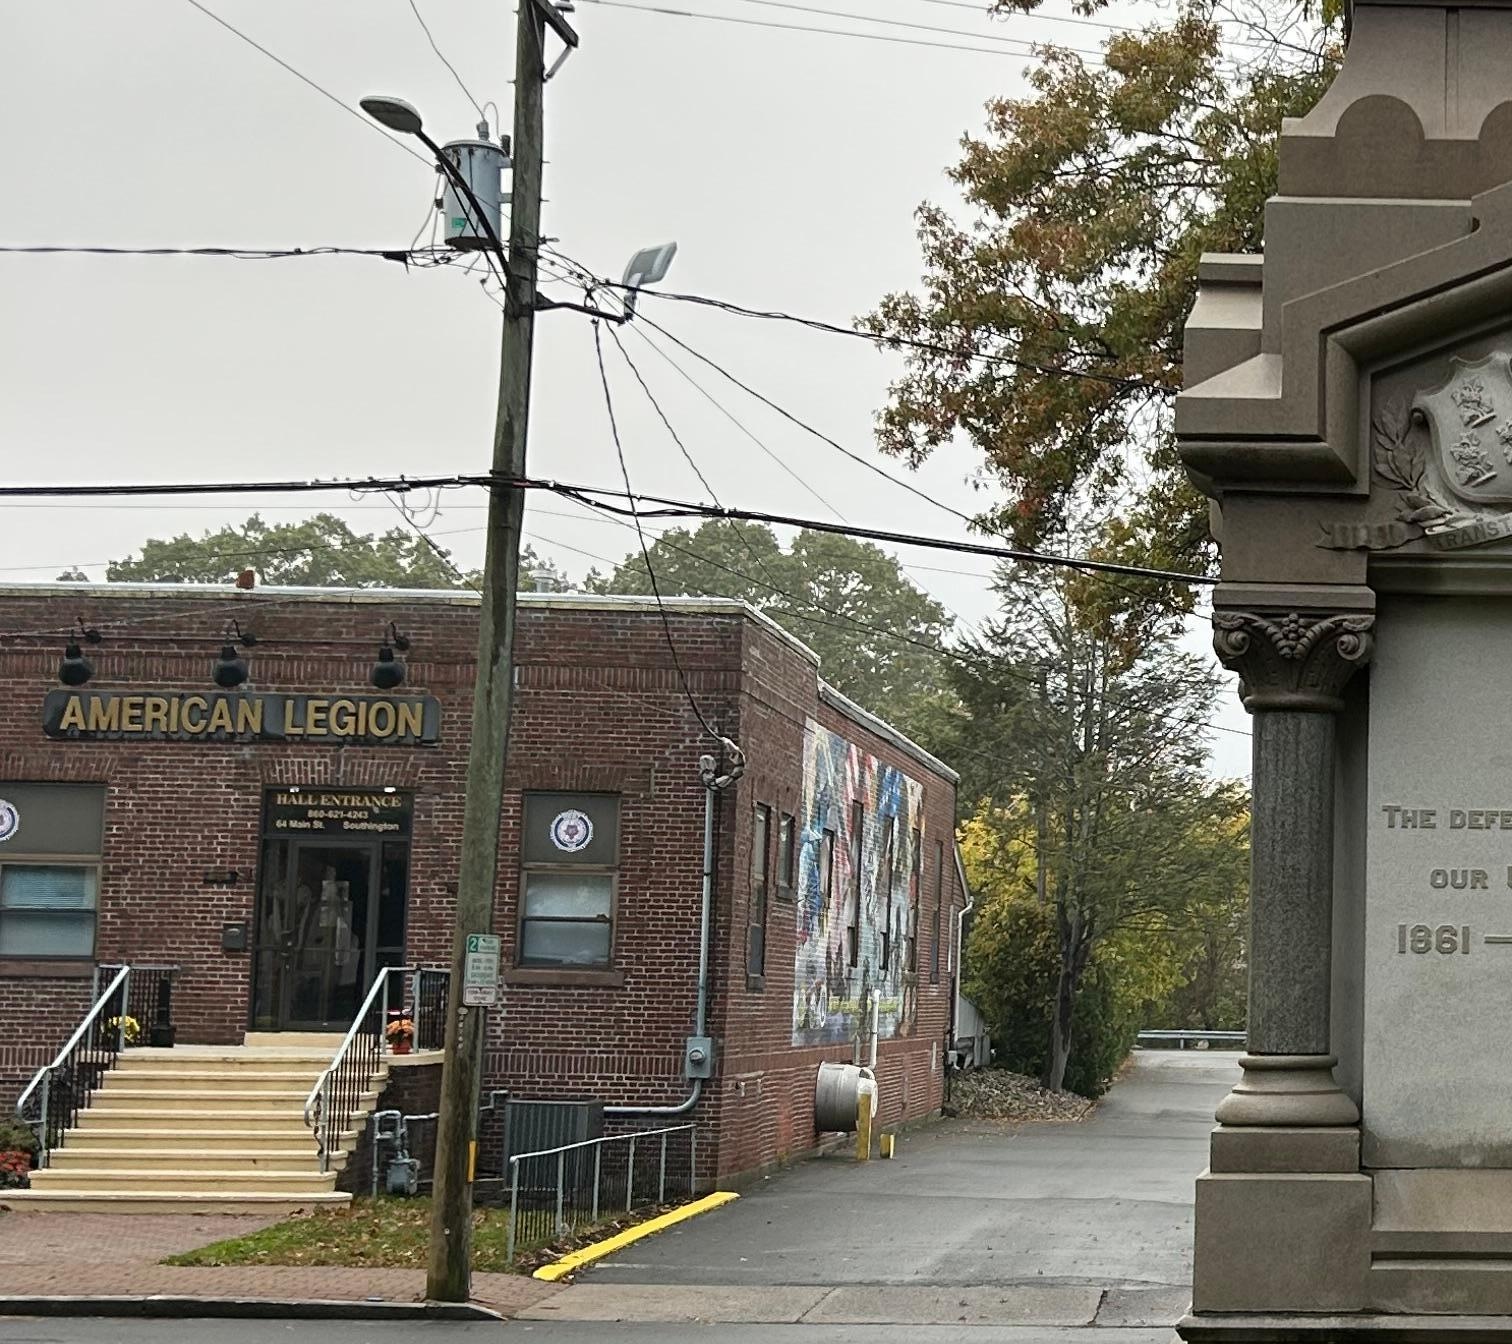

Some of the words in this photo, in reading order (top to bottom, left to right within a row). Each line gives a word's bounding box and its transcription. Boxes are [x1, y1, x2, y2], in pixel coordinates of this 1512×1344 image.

[59, 695, 263, 735] AMERICAN
[284, 699, 424, 738] LEGION
[276, 793, 317, 806] HALL
[320, 794, 402, 808] ENTRANCE
[289, 820, 311, 829] Main
[1382, 805, 1437, 830] THE
[343, 821, 399, 832] Southington
[1430, 868, 1489, 890] OUR
[469, 937, 478, 952] 2
